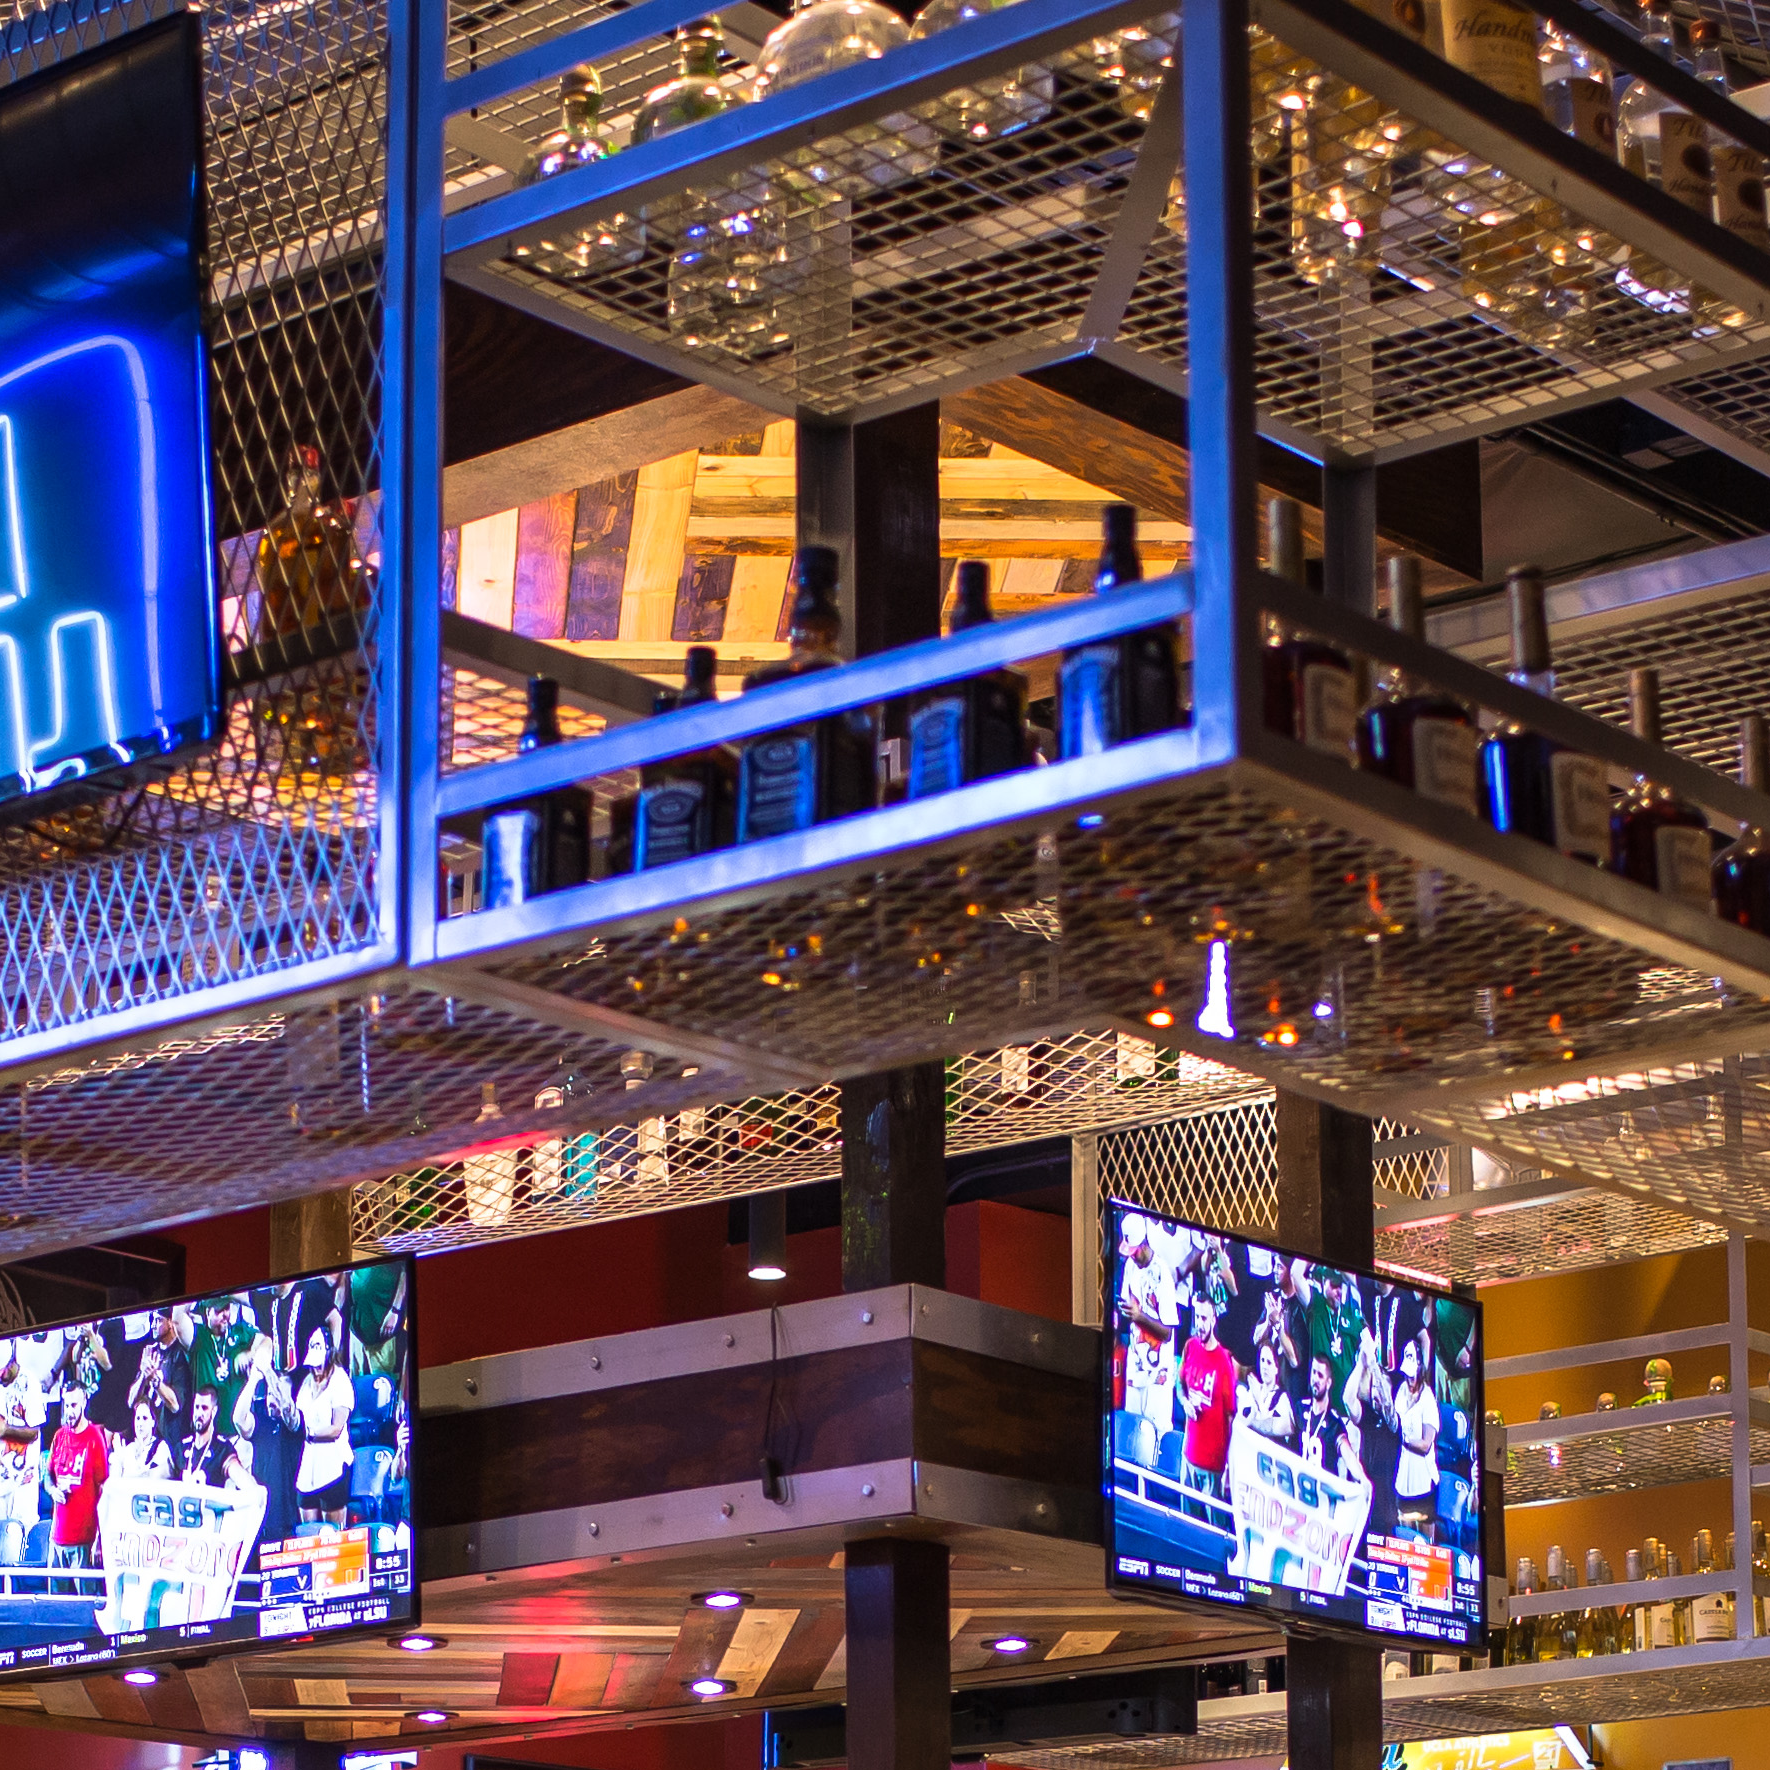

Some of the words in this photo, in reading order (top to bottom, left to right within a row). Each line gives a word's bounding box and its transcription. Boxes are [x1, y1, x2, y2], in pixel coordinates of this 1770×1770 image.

[375, 1555, 401, 1569] 8:55
[1456, 1582, 1475, 1596] 8:55
[1423, 1738, 1454, 1752] UCLA
[1454, 1735, 1510, 1750] ATHLETICS
